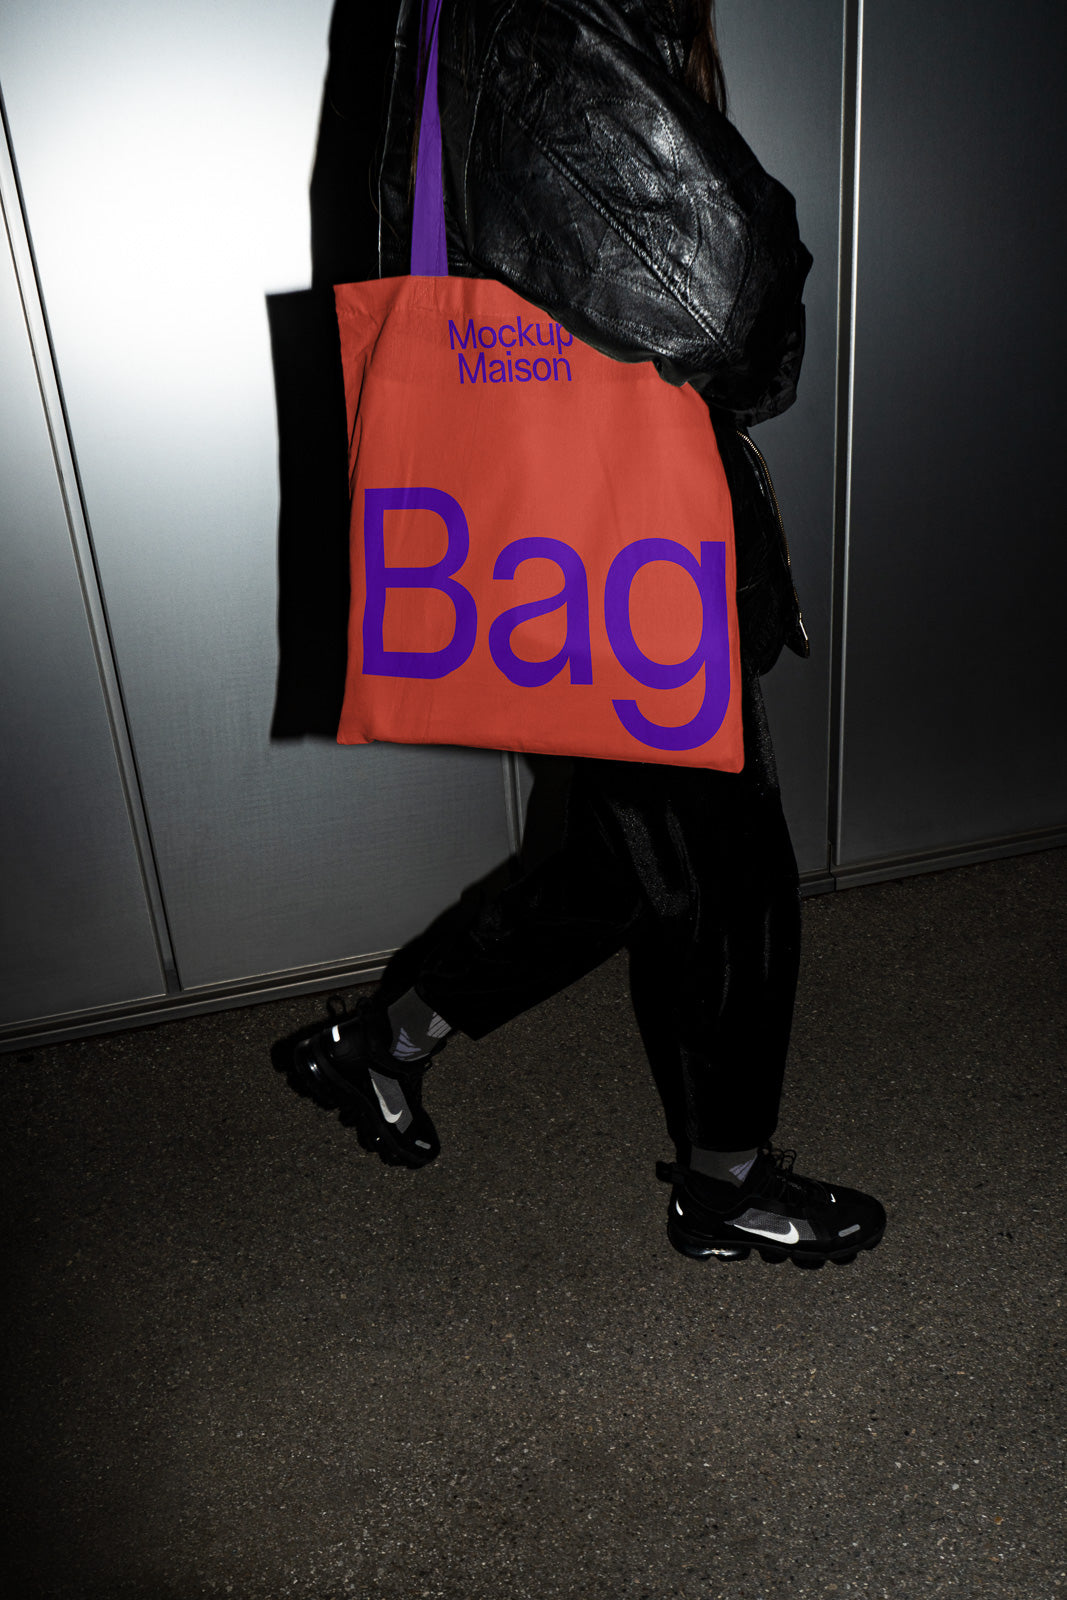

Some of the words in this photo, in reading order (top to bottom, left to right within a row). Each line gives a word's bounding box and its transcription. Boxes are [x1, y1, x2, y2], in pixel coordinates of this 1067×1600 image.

[448, 316, 573, 354] Mockup
[458, 351, 572, 384] Maison
[362, 487, 731, 751] Bag
